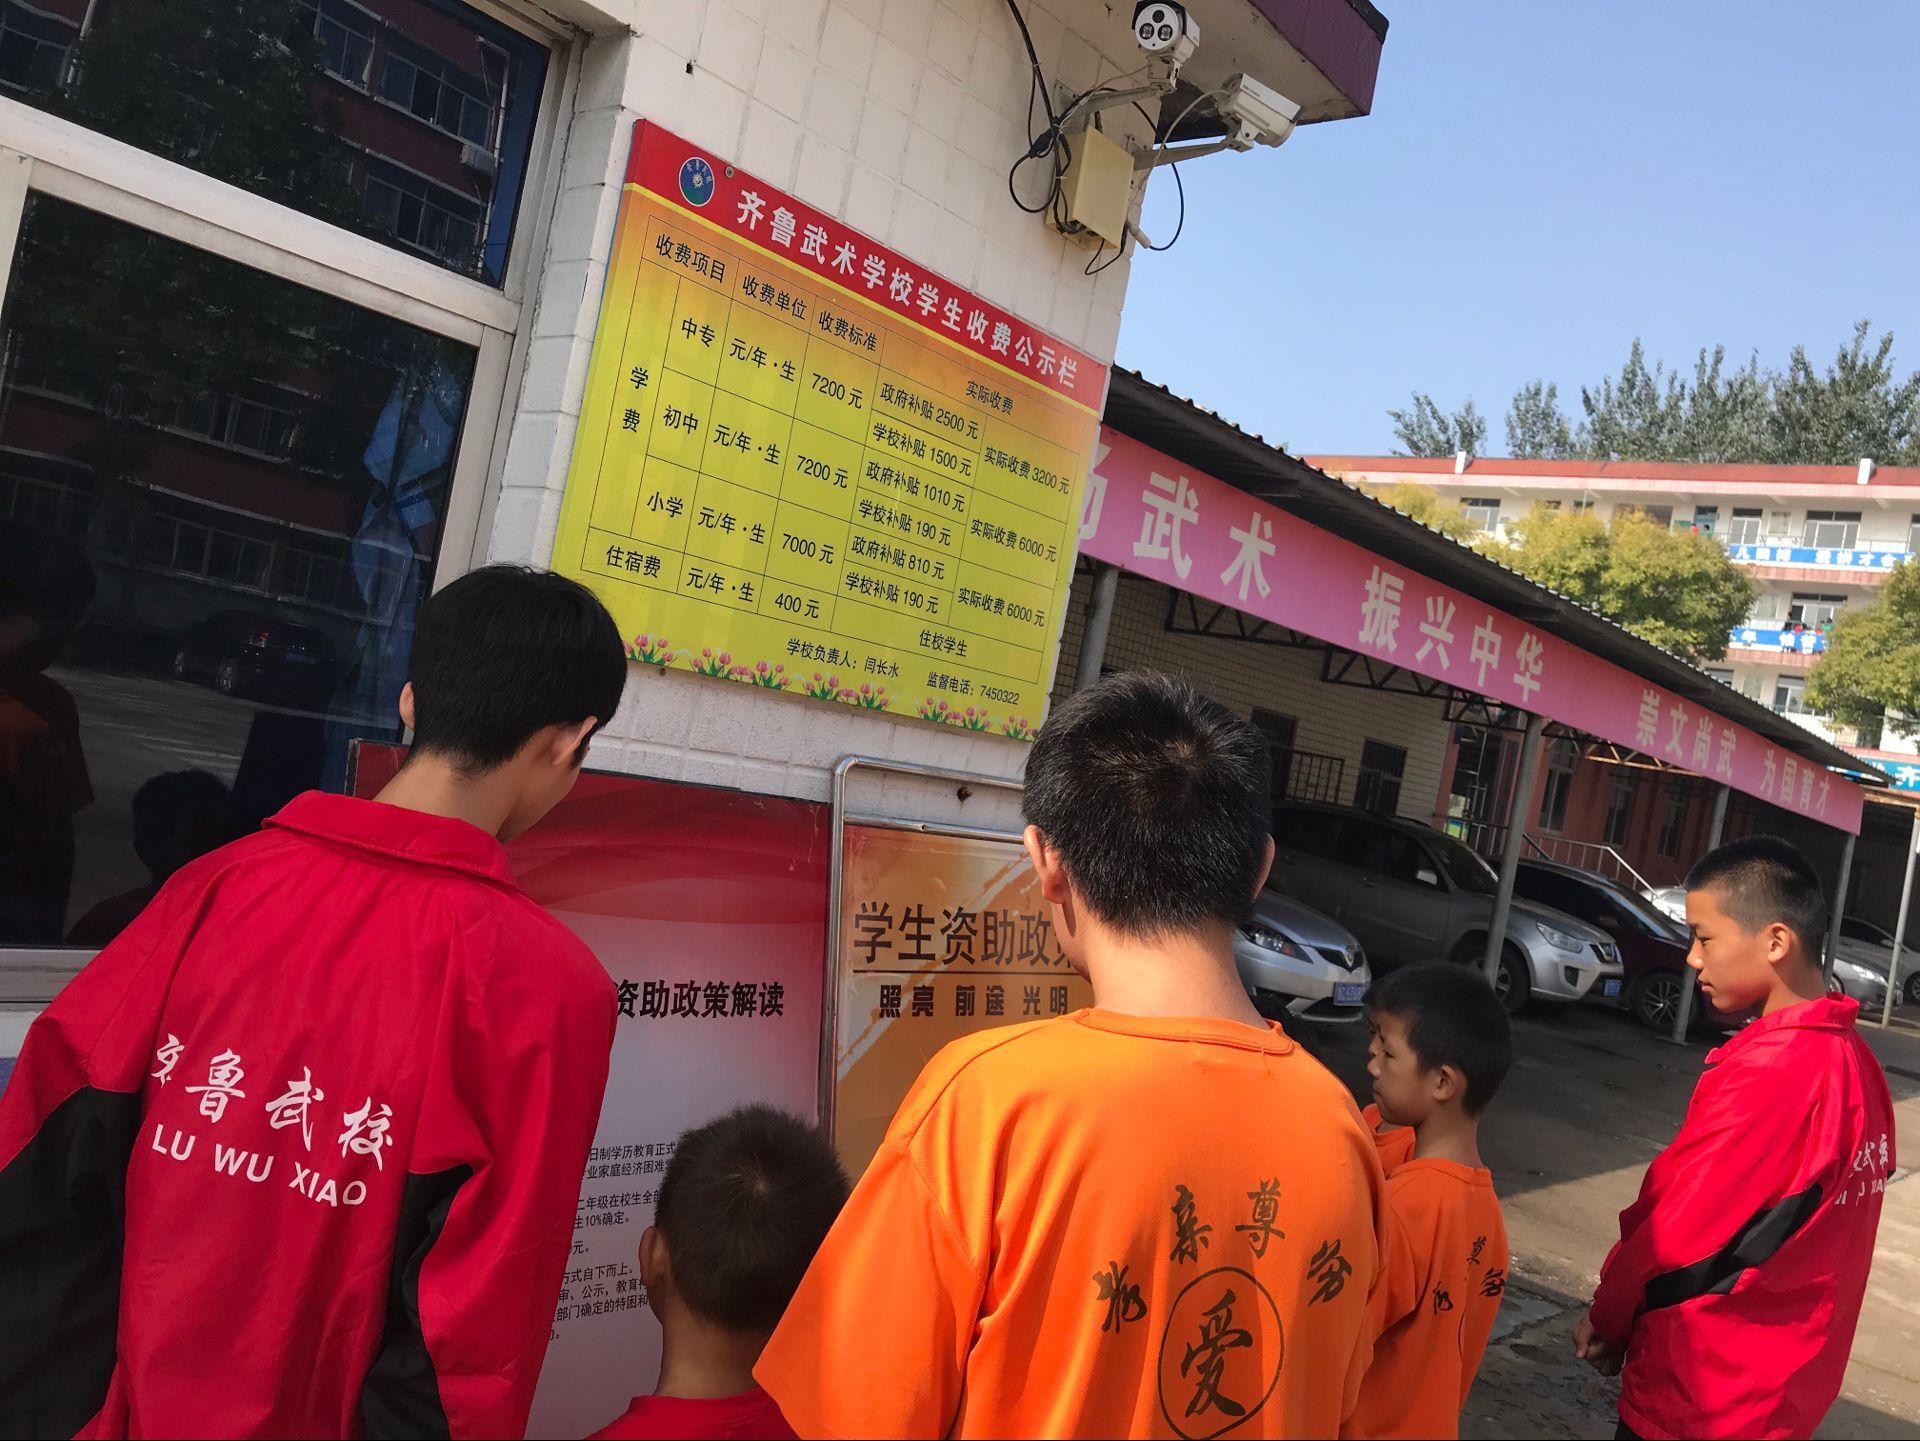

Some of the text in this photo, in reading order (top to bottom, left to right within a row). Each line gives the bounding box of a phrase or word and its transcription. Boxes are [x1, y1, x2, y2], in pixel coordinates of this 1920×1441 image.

[656, 233, 725, 283] 收费项目
[737, 190, 1077, 388] 齐鲁武术学校学生收费公示栏
[742, 275, 807, 320] 收费单位
[681, 318, 716, 348] 中专
[818, 310, 877, 351] 收费标准
[965, 380, 1014, 415] 实际收费
[663, 405, 699, 434] 初中
[646, 491, 684, 518] 小学
[606, 545, 661, 578] 住宿费
[919, 629, 968, 658] 住校学生
[1359, 565, 1544, 702] 振兴中华
[1636, 689, 1737, 780] 崇文尚武
[1760, 748, 1830, 817] 为国育才
[853, 901, 1071, 968] 学生资助政
[615, 979, 784, 1018] 资助政策解读
[879, 984, 1067, 1018] 照亮 前途 光明
[152, 1124, 367, 1208] LU WU XIAO
[584, 1159, 671, 1180] 业家庭经济困难
[553, 1293, 648, 1322] 部门确定的特困和
[1181, 1289, 1253, 1418] 爱
